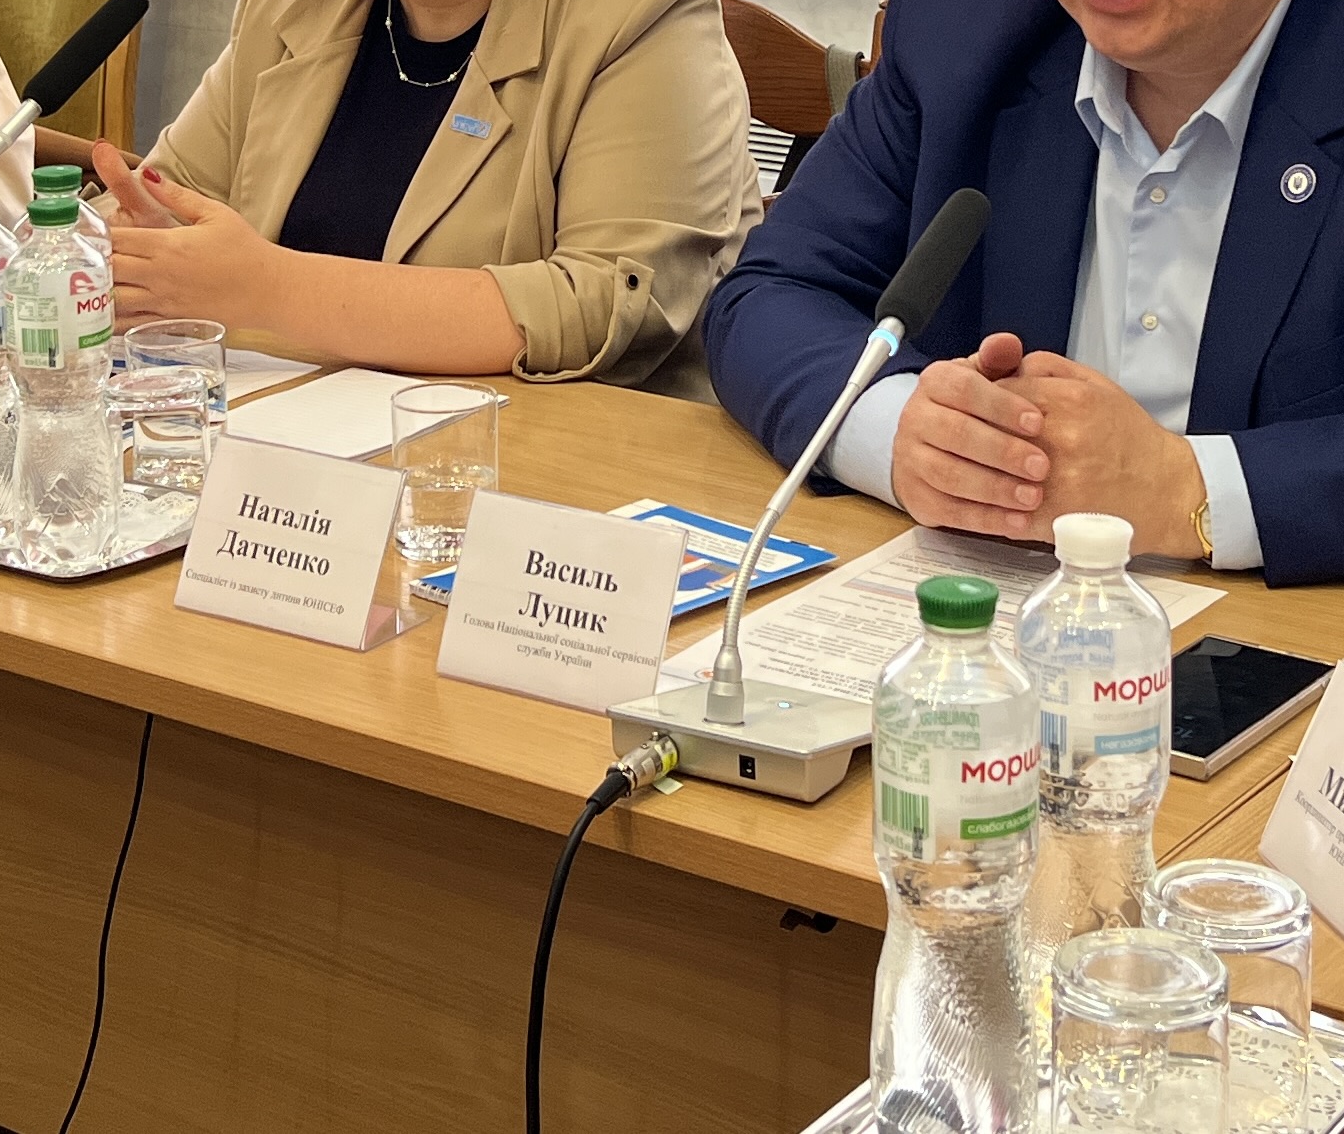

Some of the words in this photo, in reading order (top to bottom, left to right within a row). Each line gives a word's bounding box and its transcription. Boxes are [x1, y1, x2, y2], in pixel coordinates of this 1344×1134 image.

[238, 493, 332, 536] Наталія
[216, 529, 330, 576] Датченко
[525, 549, 618, 593] Василь
[185, 568, 228, 588] Спеціаліст
[238, 582, 269, 599] захисту
[303, 596, 344, 615] ЮНІСЕФ
[519, 591, 607, 634] Луцик
[463, 613, 495, 631] Голова
[497, 621, 558, 644] Національної
[560, 636, 610, 657] соціальної
[612, 648, 659, 667] сервісної
[517, 644, 551, 659] служби
[553, 649, 592, 668] України
